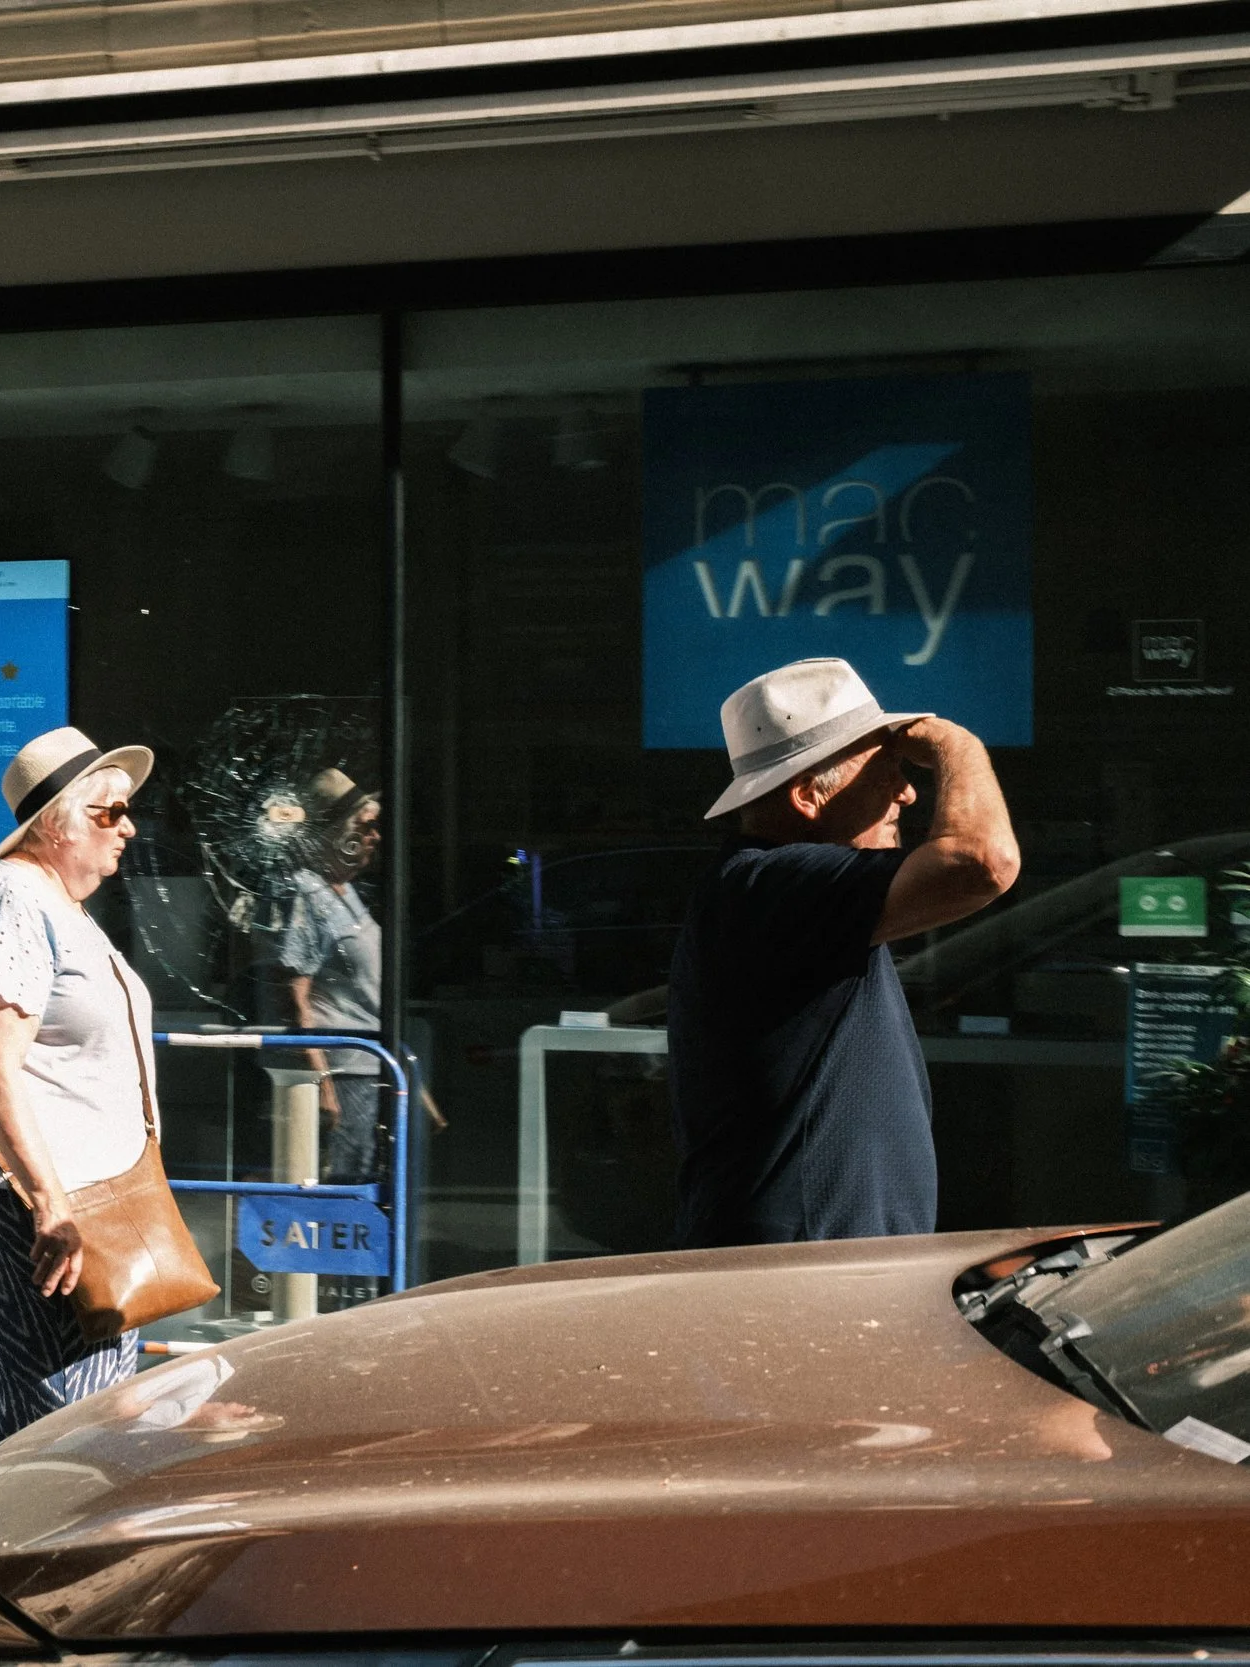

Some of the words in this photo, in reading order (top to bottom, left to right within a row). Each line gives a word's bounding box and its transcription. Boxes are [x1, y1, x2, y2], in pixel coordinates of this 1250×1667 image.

[694, 476, 976, 547] mac
[693, 552, 976, 666] way
[261, 1219, 371, 1251] SATER
